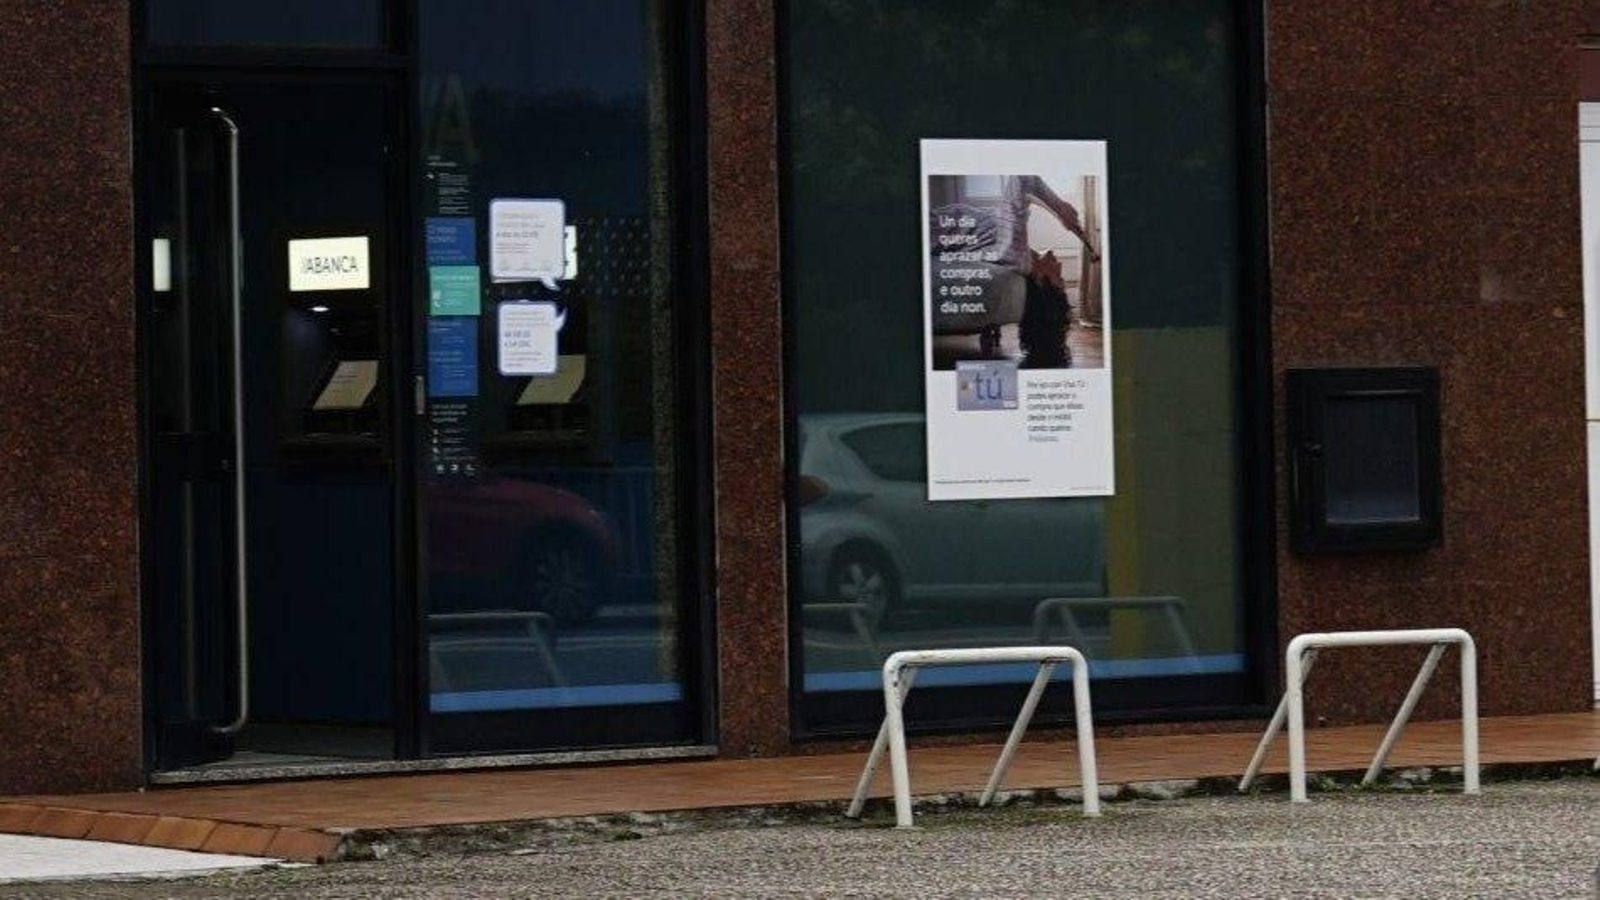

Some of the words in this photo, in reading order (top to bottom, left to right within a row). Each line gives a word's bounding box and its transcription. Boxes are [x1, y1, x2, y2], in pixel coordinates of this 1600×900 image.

[939, 215, 956, 228] Un
[940, 286, 949, 296] e
[950, 285, 982, 296] outro
[960, 303, 987, 313] non.
